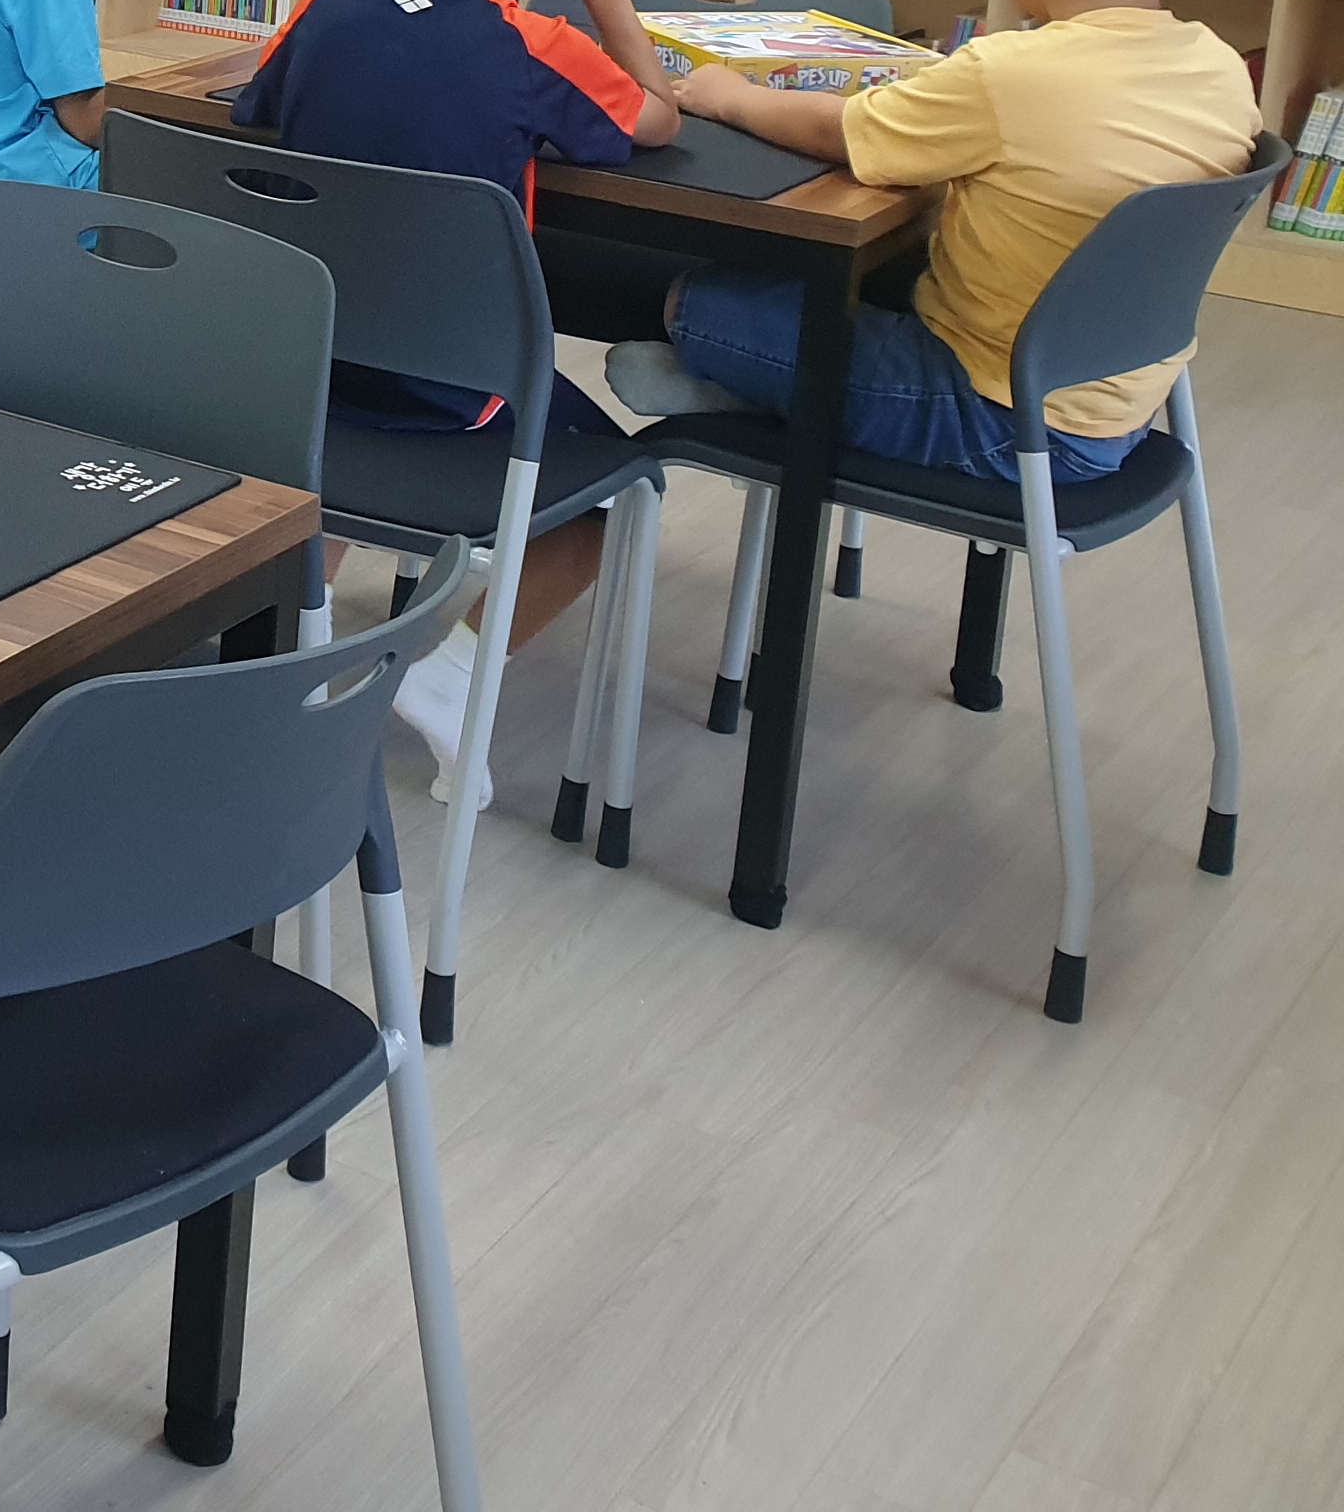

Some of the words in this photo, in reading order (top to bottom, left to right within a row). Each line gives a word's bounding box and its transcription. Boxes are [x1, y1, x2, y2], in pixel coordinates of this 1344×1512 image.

[765, 66, 826, 90] SHAPES
[828, 69, 852, 89] UP
[60, 461, 111, 480] 생각
[87, 466, 142, 490] 더하기
